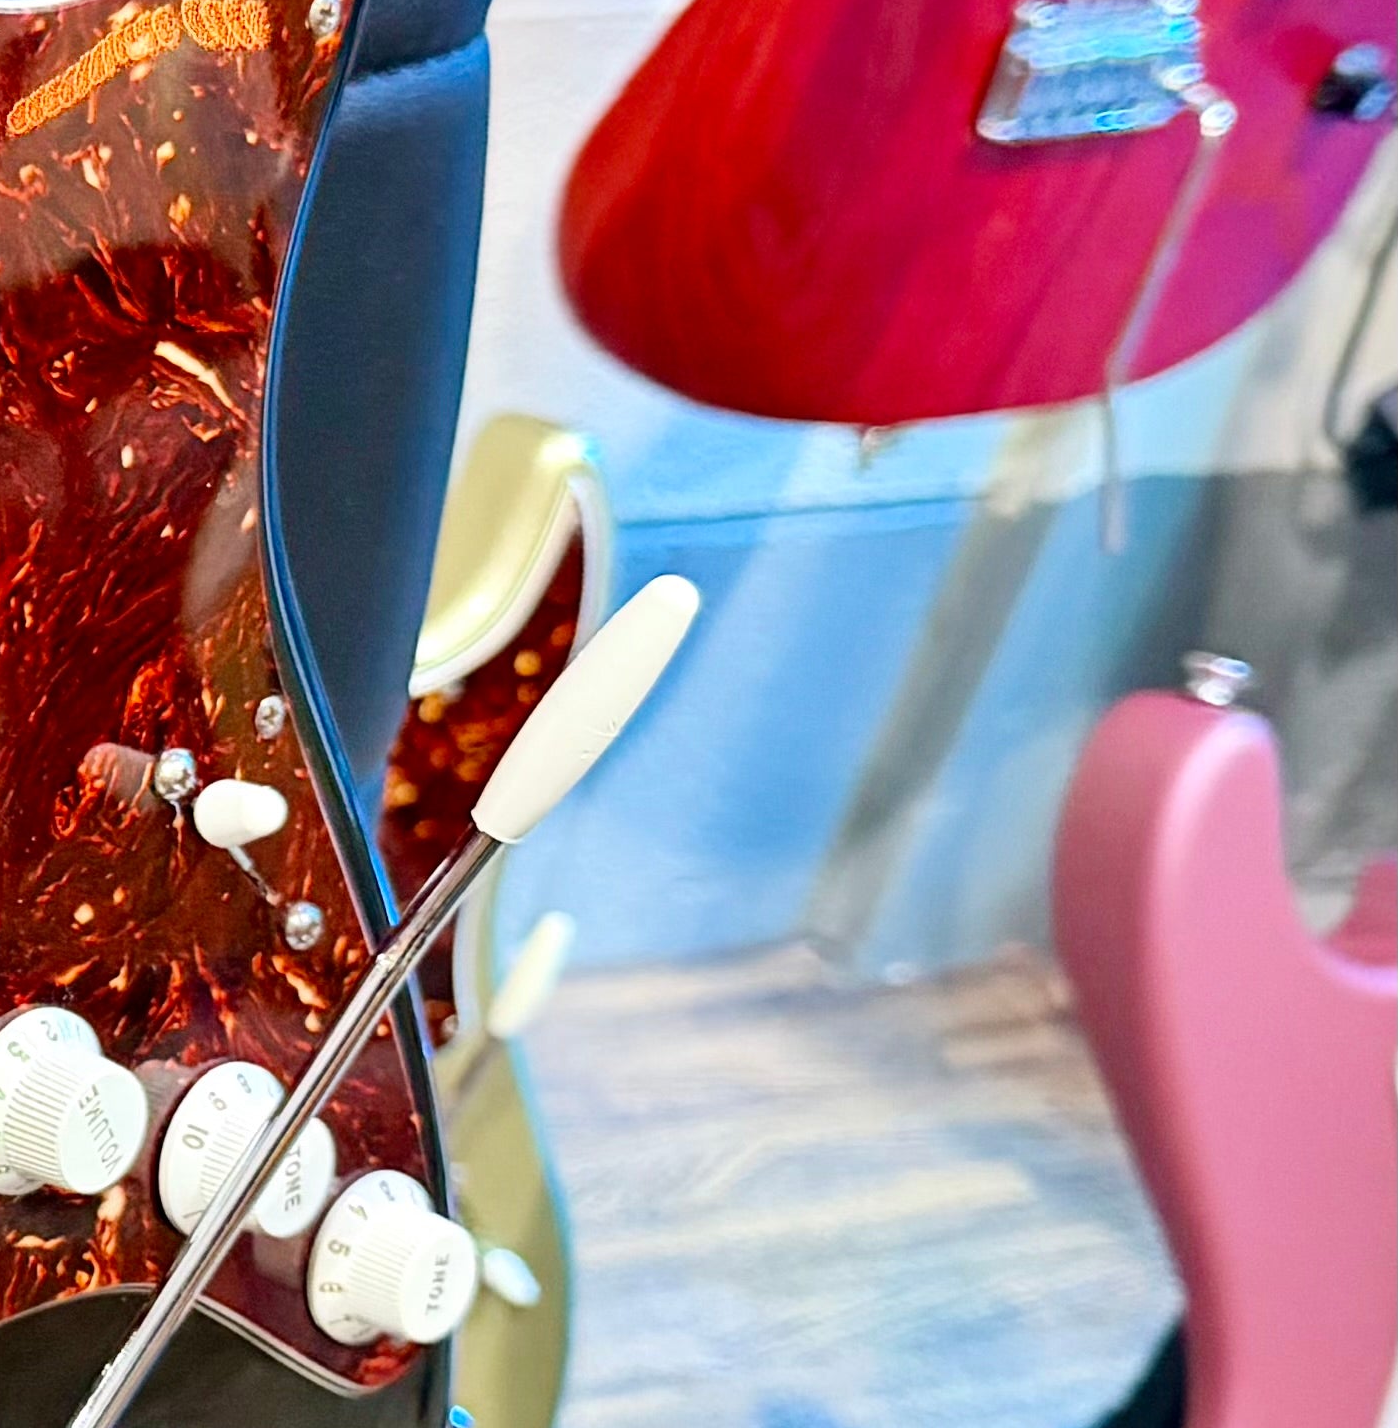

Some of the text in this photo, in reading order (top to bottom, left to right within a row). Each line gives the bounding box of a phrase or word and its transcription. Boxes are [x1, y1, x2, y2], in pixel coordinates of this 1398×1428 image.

[78, 1083, 124, 1175] VOLUME
[181, 1123, 210, 1151] 10
[284, 1145, 302, 1213] TONE
[326, 1238, 352, 1258] 5
[424, 1252, 451, 1317] TONE
